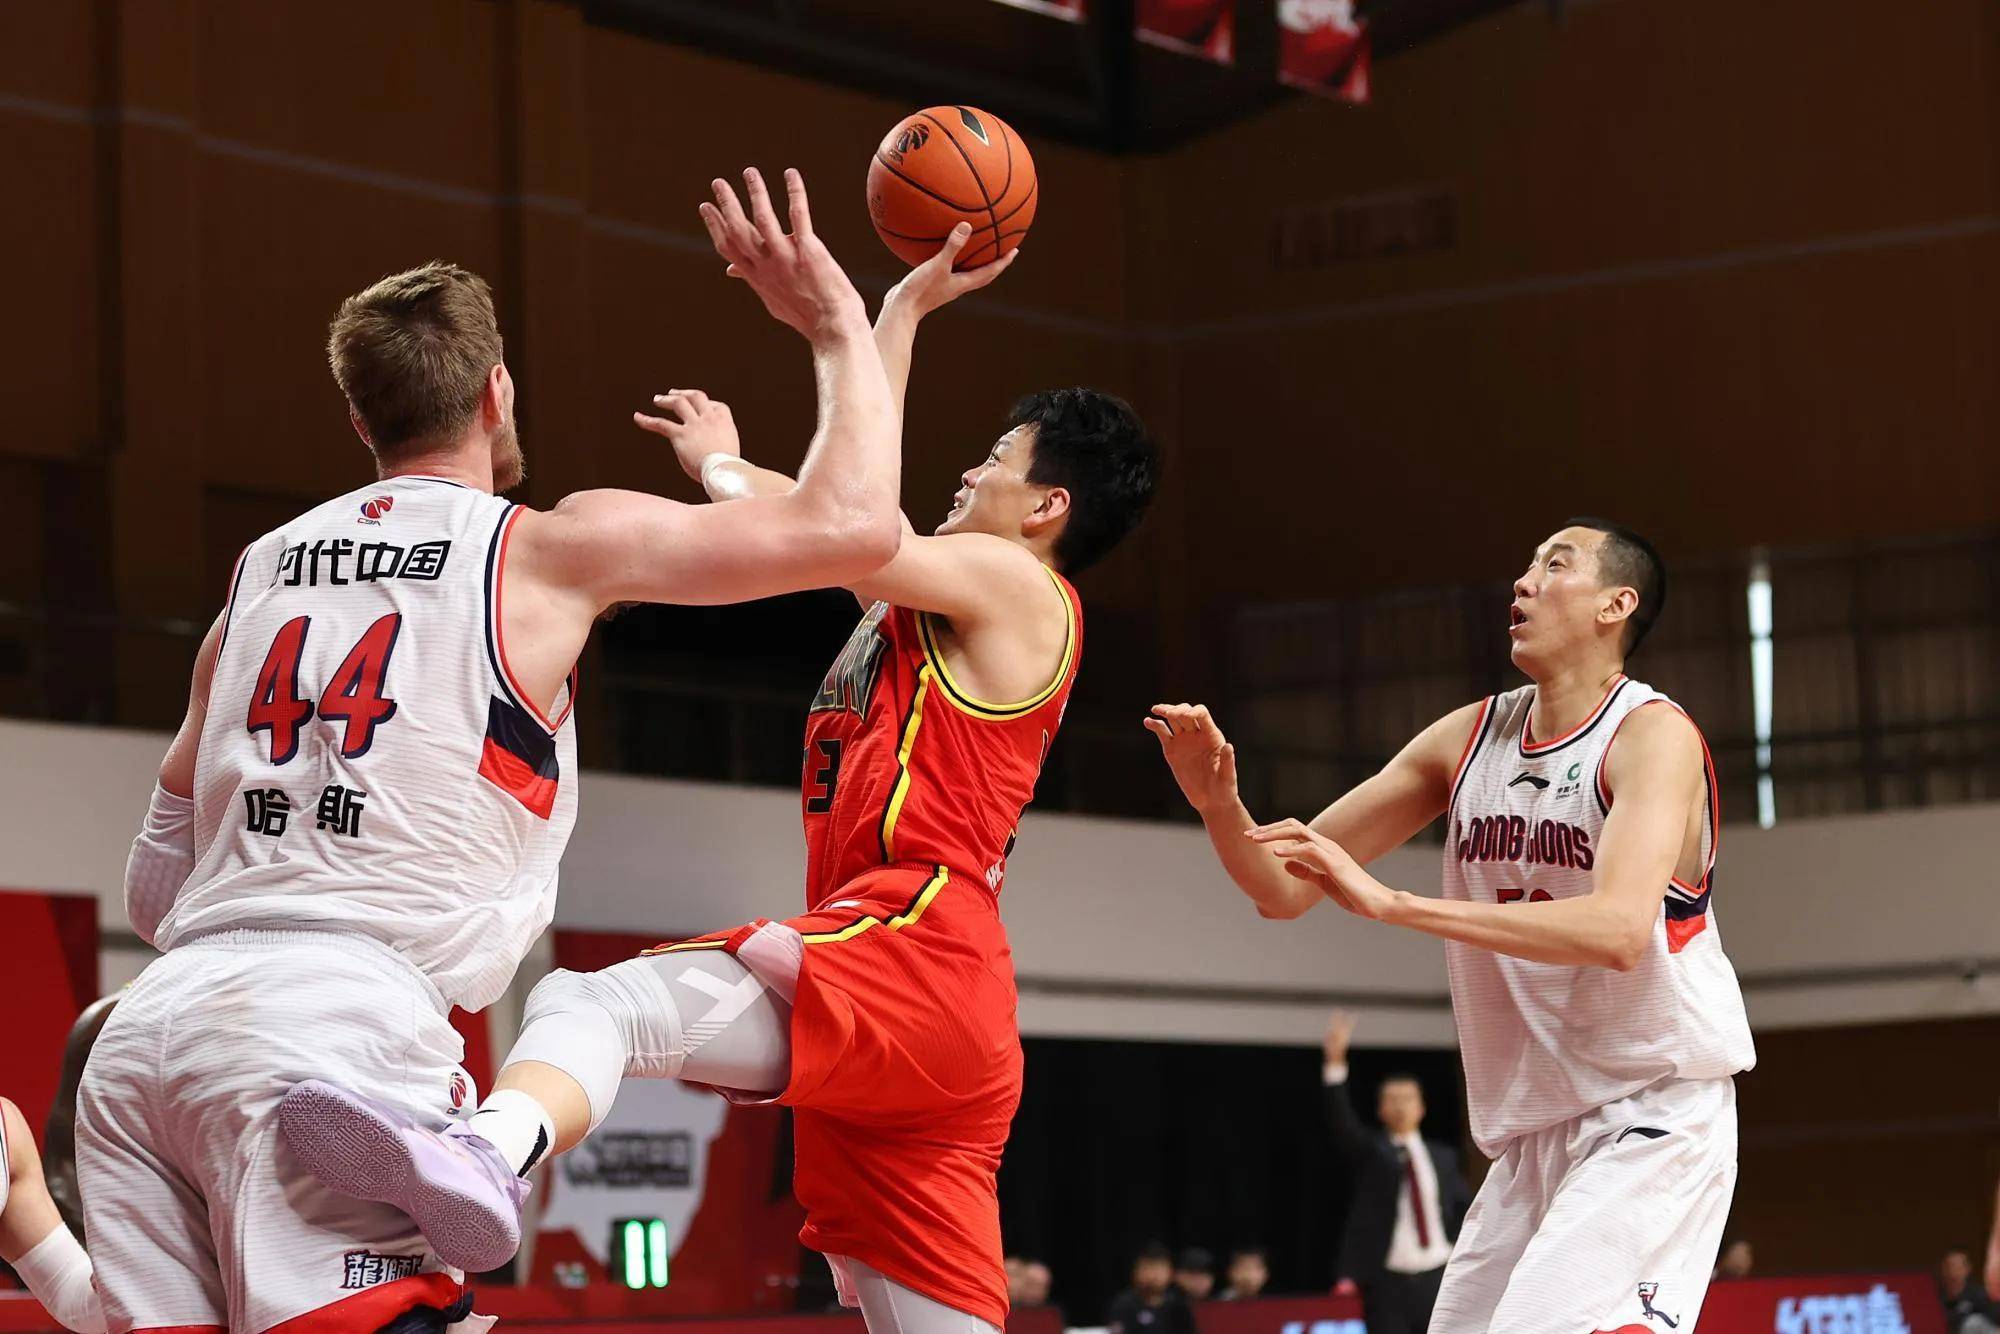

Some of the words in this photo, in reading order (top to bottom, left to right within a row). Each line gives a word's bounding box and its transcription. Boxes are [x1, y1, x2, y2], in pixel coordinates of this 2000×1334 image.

[246, 612, 402, 766] 44
[243, 784, 367, 838] 哈斯
[623, 1218, 669, 1290] 11
